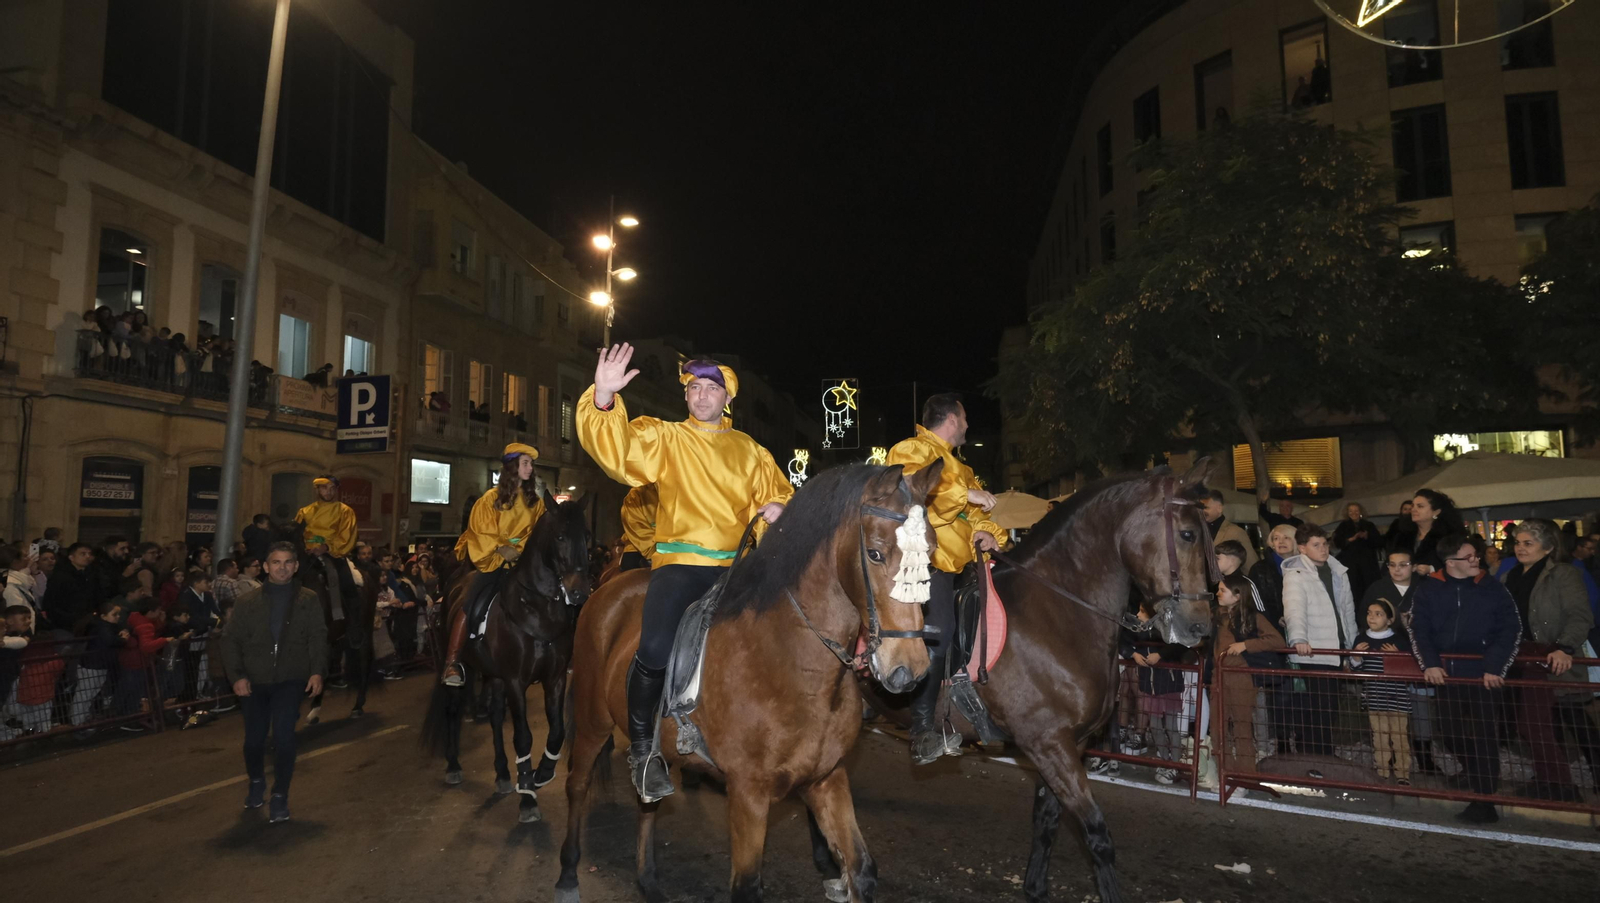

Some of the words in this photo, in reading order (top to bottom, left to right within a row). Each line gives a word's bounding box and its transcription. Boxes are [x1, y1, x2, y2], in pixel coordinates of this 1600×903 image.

[350, 382, 376, 425] P
[89, 482, 129, 490] DISPONIBLE
[86, 489, 102, 497] 950
[103, 490, 113, 498] 27
[188, 524, 202, 532] 950
[202, 524, 210, 532] 27
